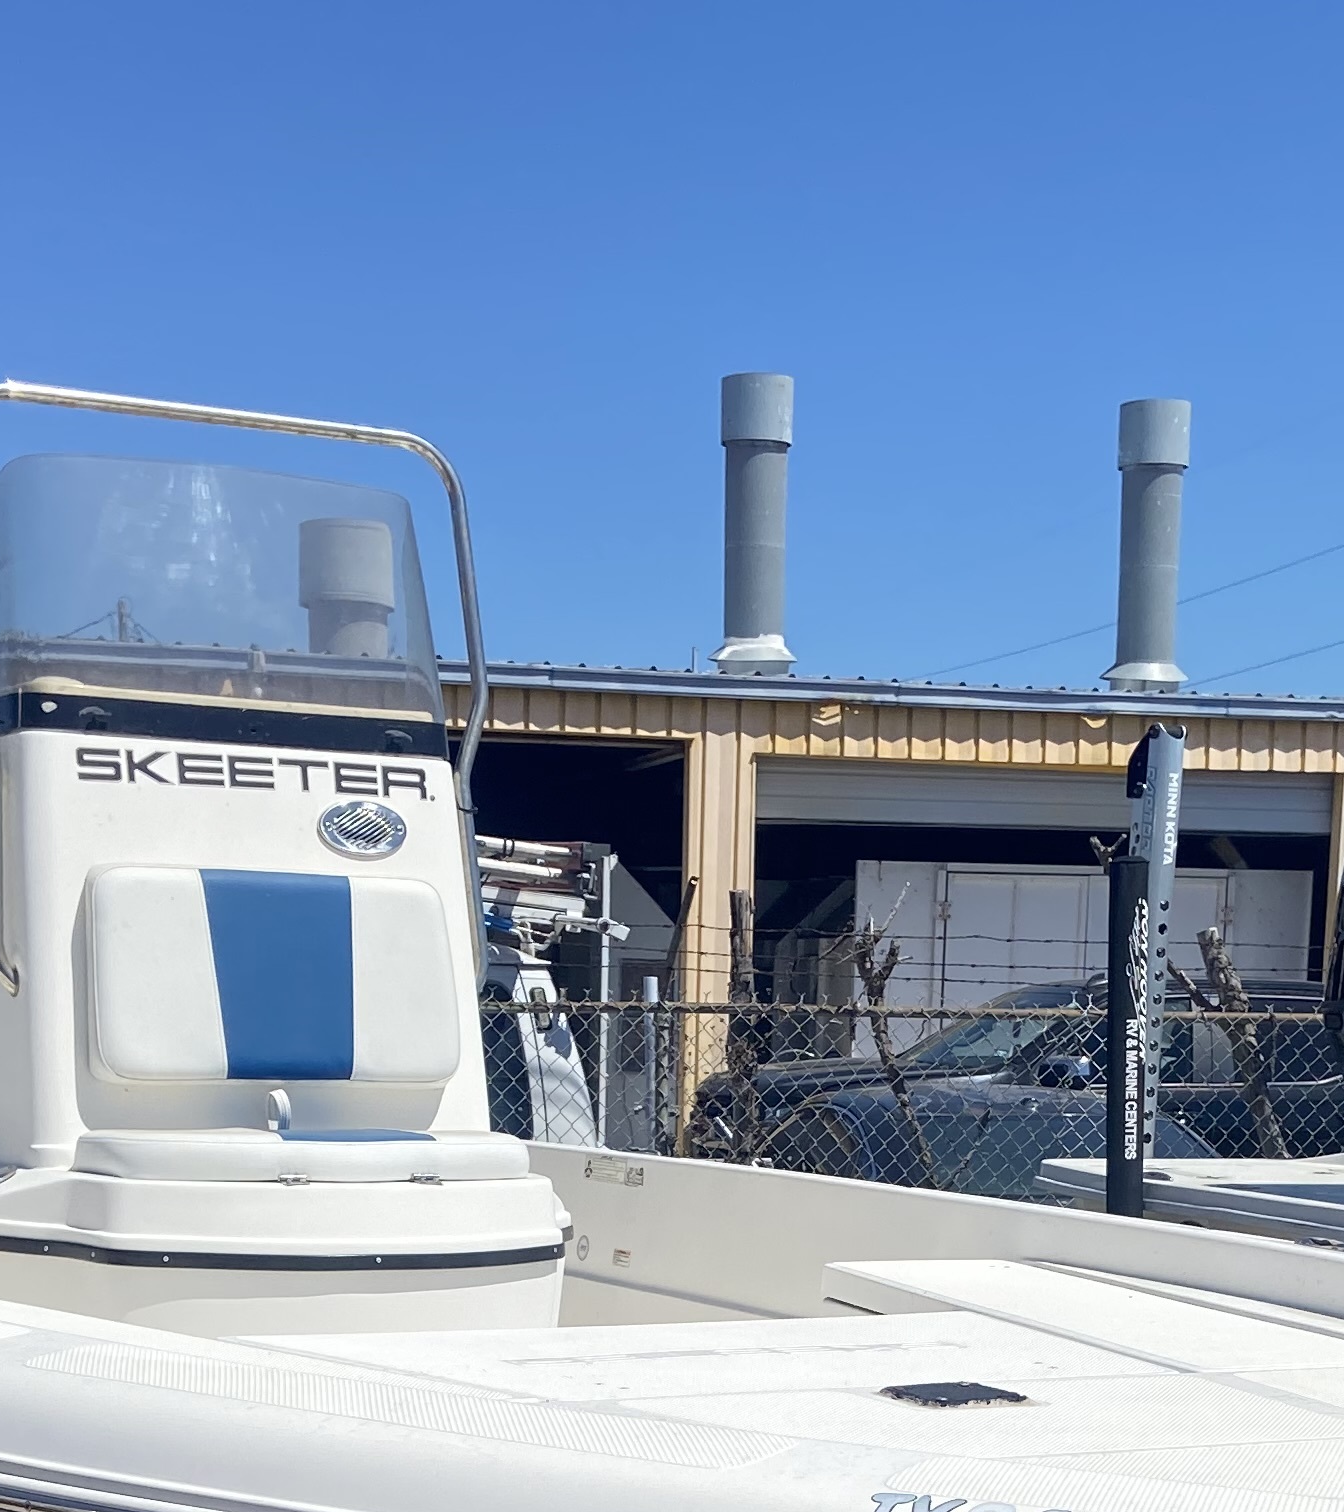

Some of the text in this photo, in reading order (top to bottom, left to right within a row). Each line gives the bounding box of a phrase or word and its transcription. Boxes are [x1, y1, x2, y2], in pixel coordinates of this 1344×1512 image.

[75, 747, 429, 801] SKEETER
[1162, 772, 1179, 866] MINN KOTA
[1124, 1018, 1138, 1160] RV & MARINE CENTERS
